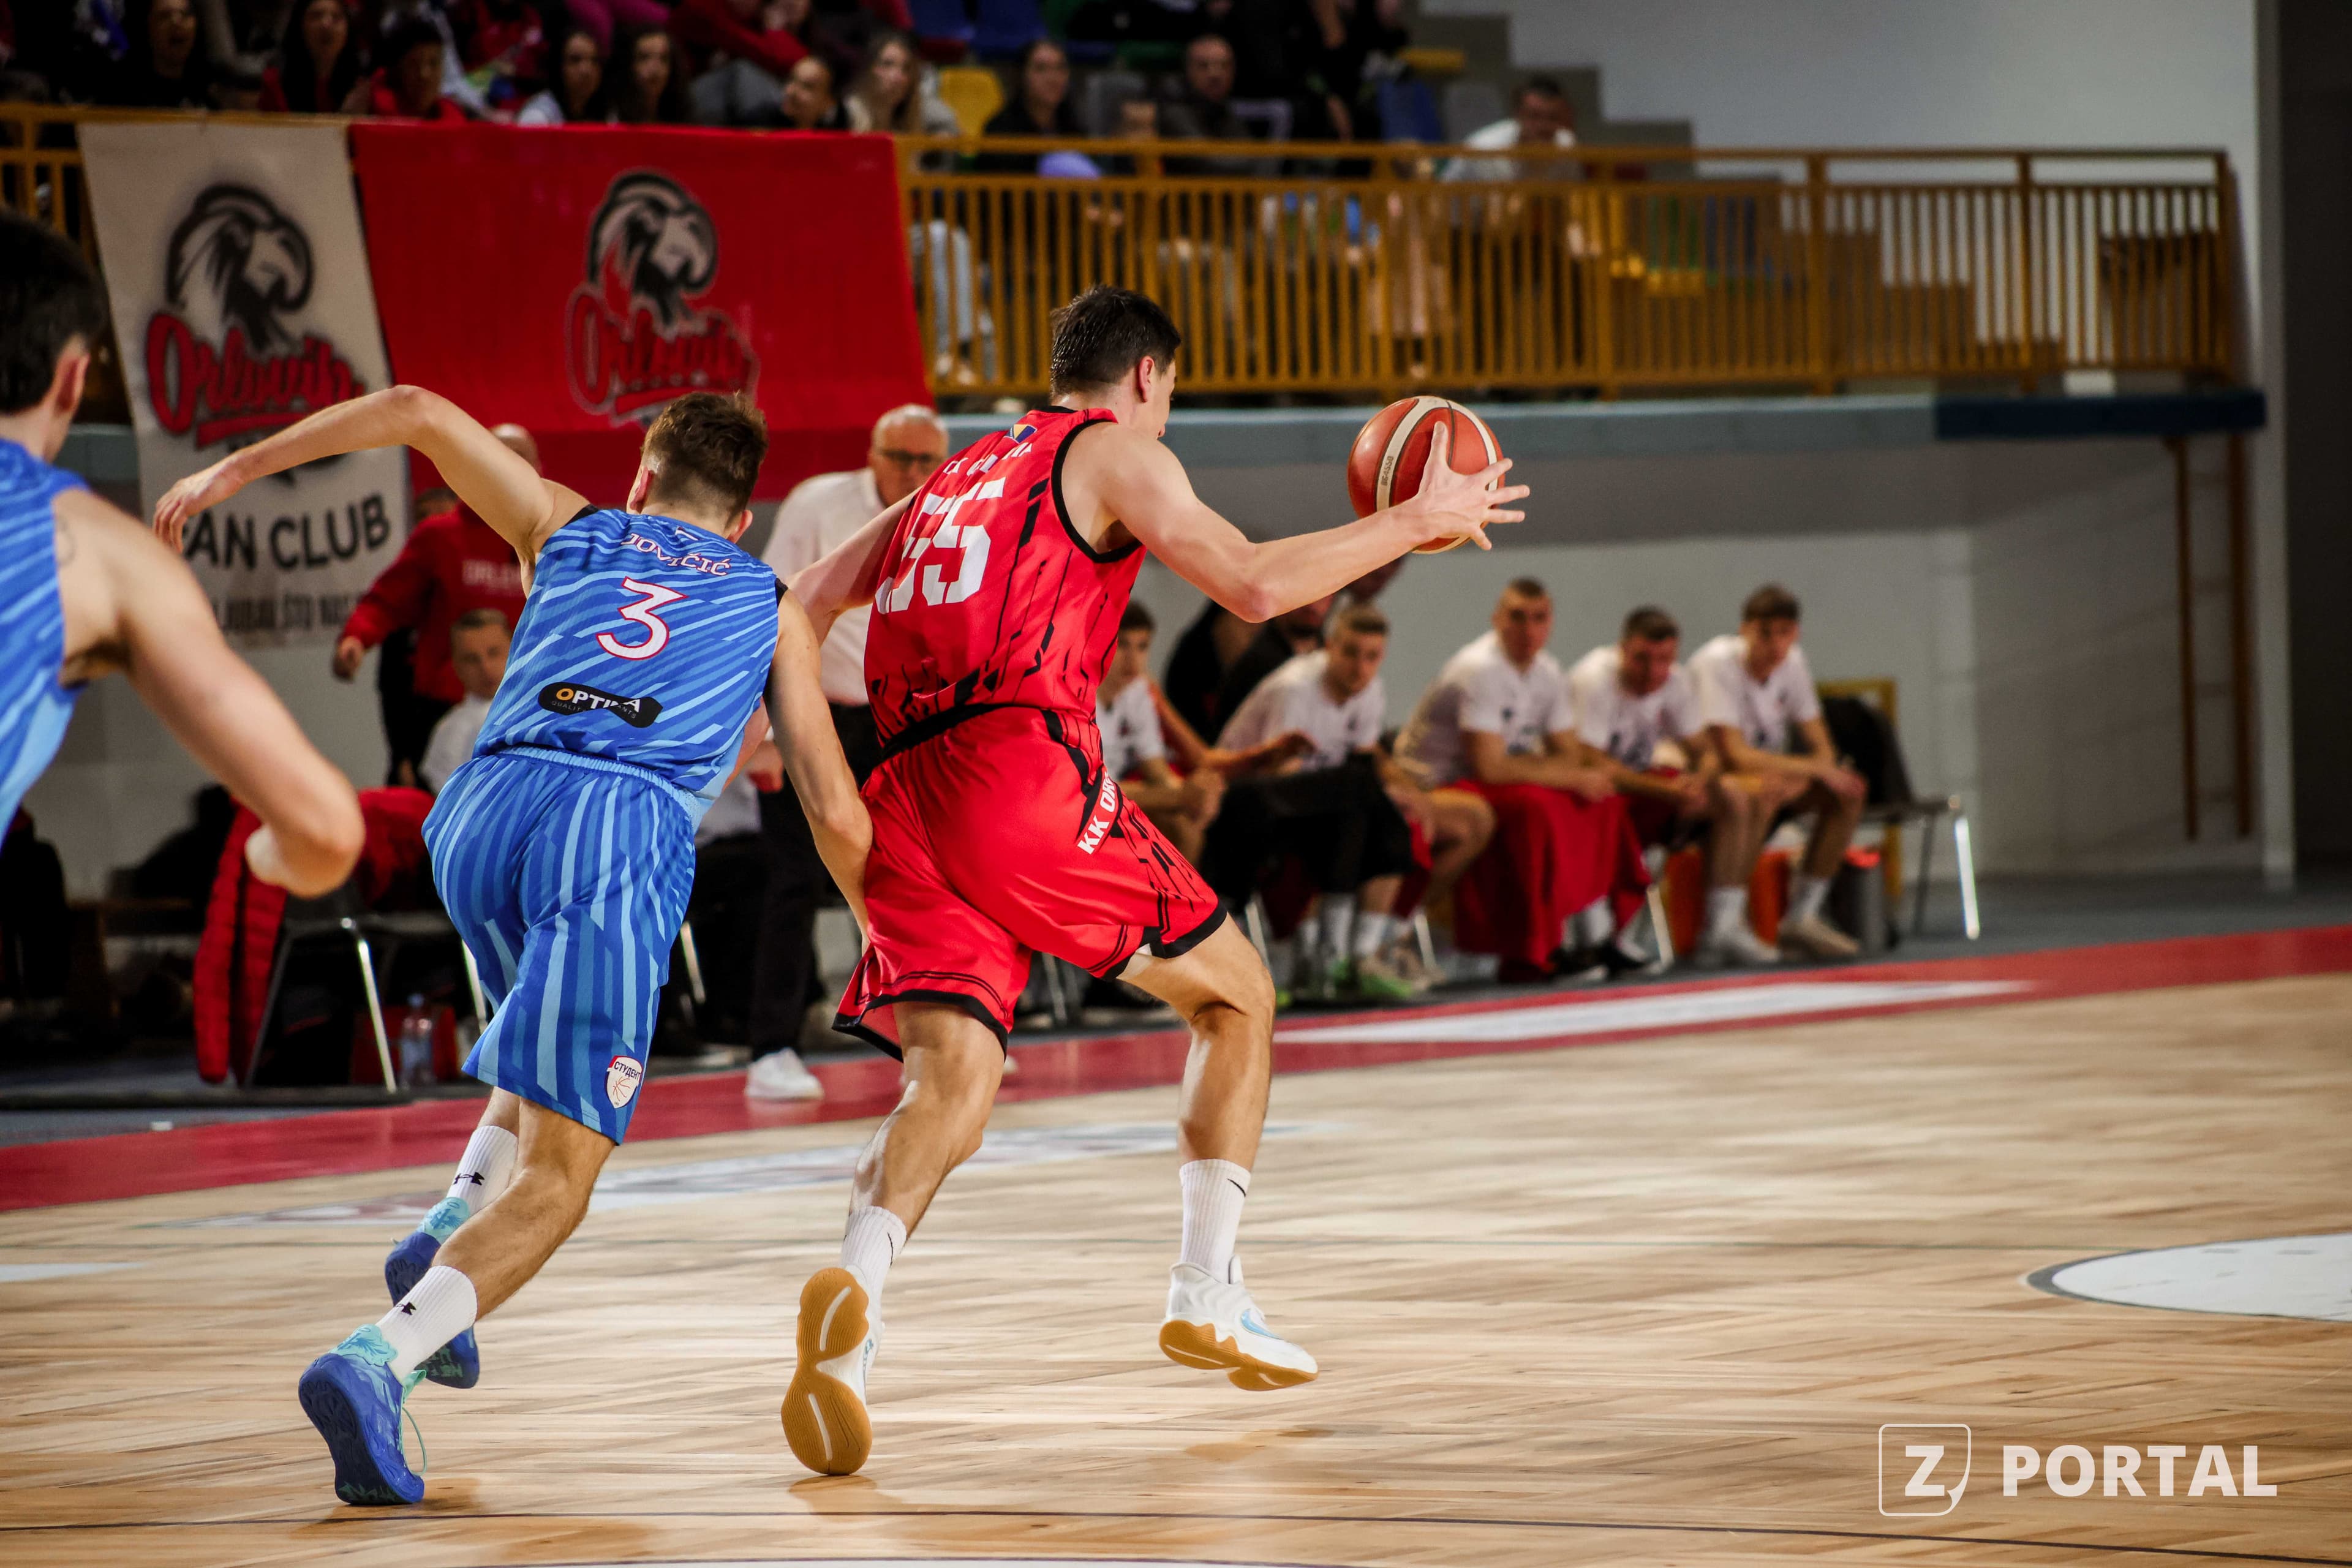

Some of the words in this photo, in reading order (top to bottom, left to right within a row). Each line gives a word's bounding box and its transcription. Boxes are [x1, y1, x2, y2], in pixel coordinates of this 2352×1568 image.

[182, 507, 257, 570] AN
[268, 492, 391, 571] CLUB
[875, 477, 1006, 614] 55
[620, 532, 732, 576] JOVIČIĆ
[596, 576, 689, 661] 3
[556, 688, 641, 712] OPTIA
[1077, 815, 1110, 855] KK
[614, 1061, 641, 1081] СТУДЕНТ
